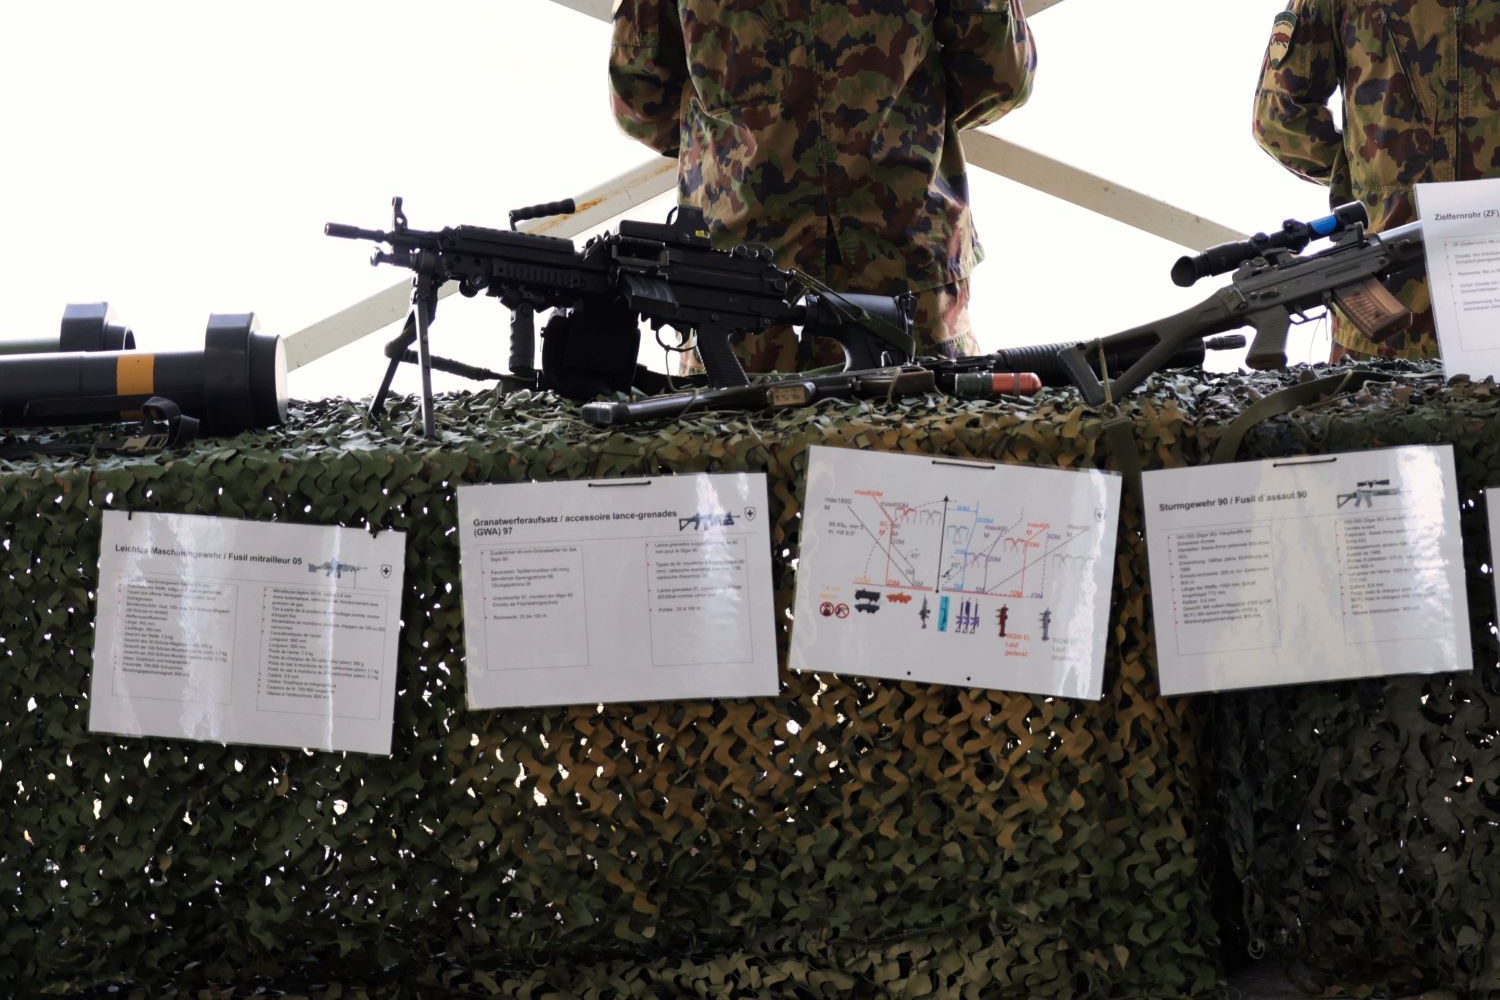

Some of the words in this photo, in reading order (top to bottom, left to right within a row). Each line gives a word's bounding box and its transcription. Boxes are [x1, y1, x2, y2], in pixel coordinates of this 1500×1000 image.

[1434, 210, 1480, 220] Zielfernrohr
[1483, 209, 1499, 217] (ZF)
[1159, 499, 1215, 512] Sturmgewehr
[1217, 497, 1227, 505] 90
[1235, 495, 1255, 503] Fusil
[1297, 490, 1306, 498] 90
[473, 515, 557, 526] Granatwerferaufsatz
[613, 510, 676, 521] lance-grenades
[474, 528, 500, 536] (GWA)
[228, 552, 247, 560] Fusil
[250, 554, 289, 563] mitrailleur
